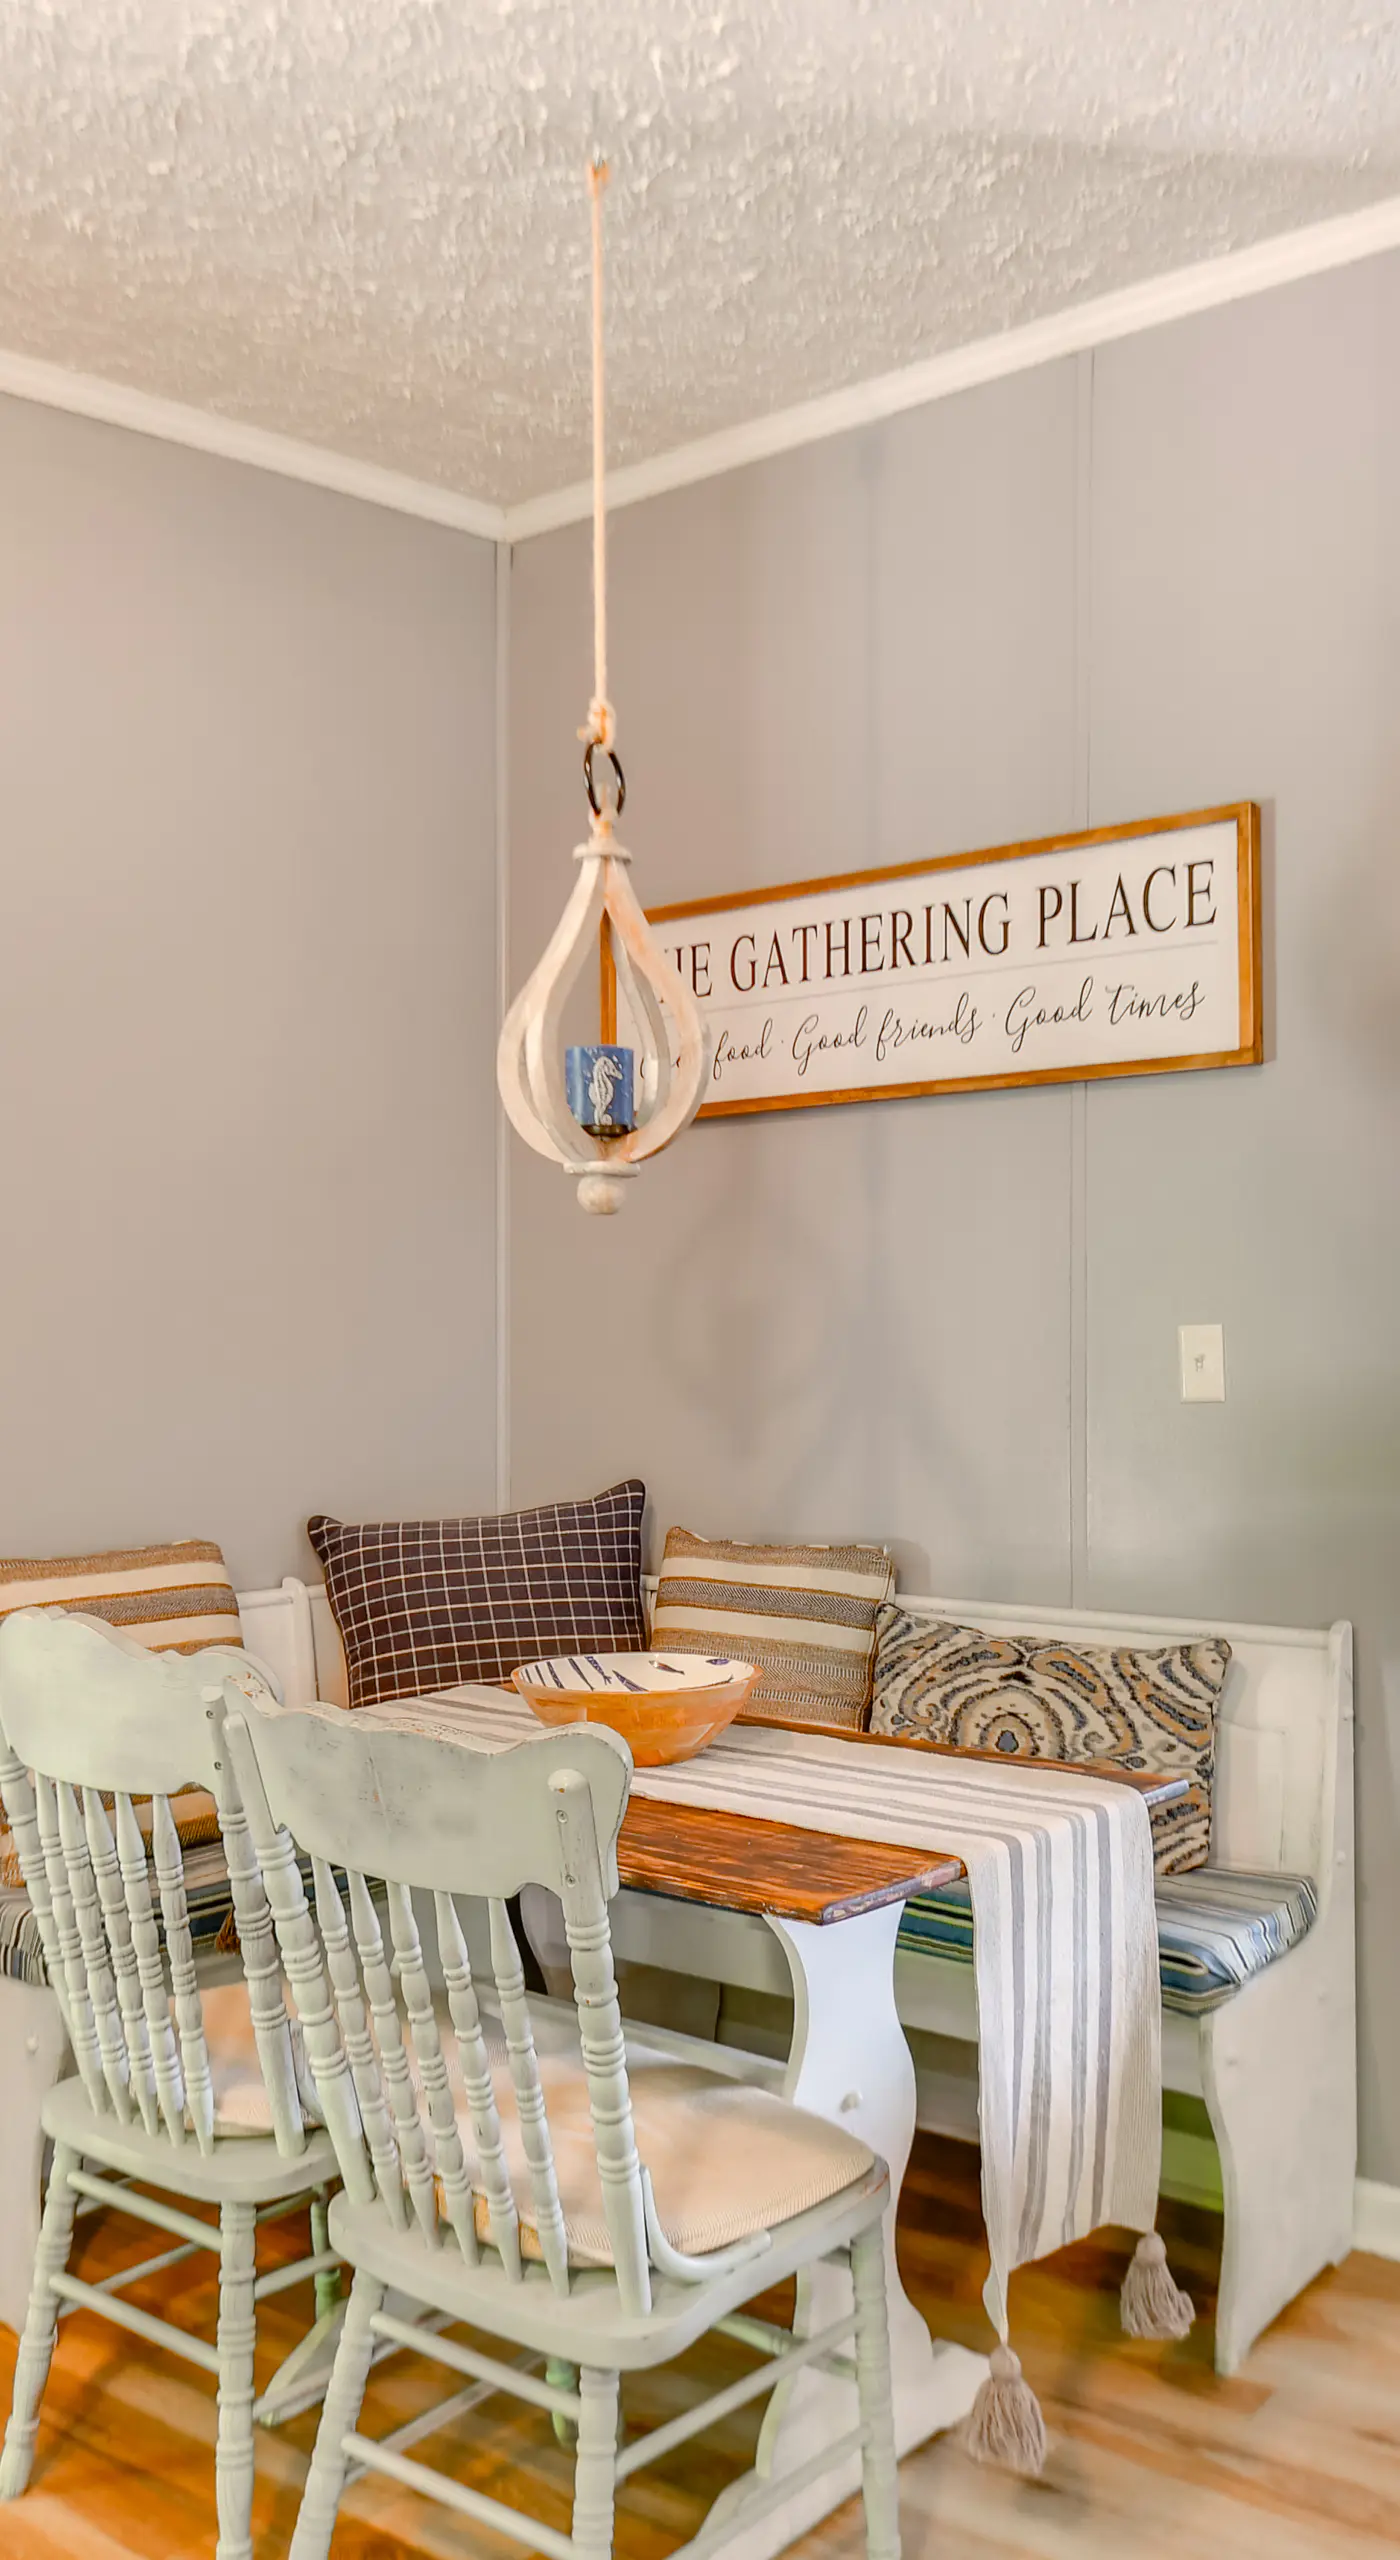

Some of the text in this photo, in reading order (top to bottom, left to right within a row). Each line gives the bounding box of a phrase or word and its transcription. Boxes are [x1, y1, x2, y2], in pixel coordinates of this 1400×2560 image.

[729, 891, 1013, 993] GATHERING
[1034, 859, 1218, 950] PLACE
[712, 975, 1206, 1080] food Good friends Good times
